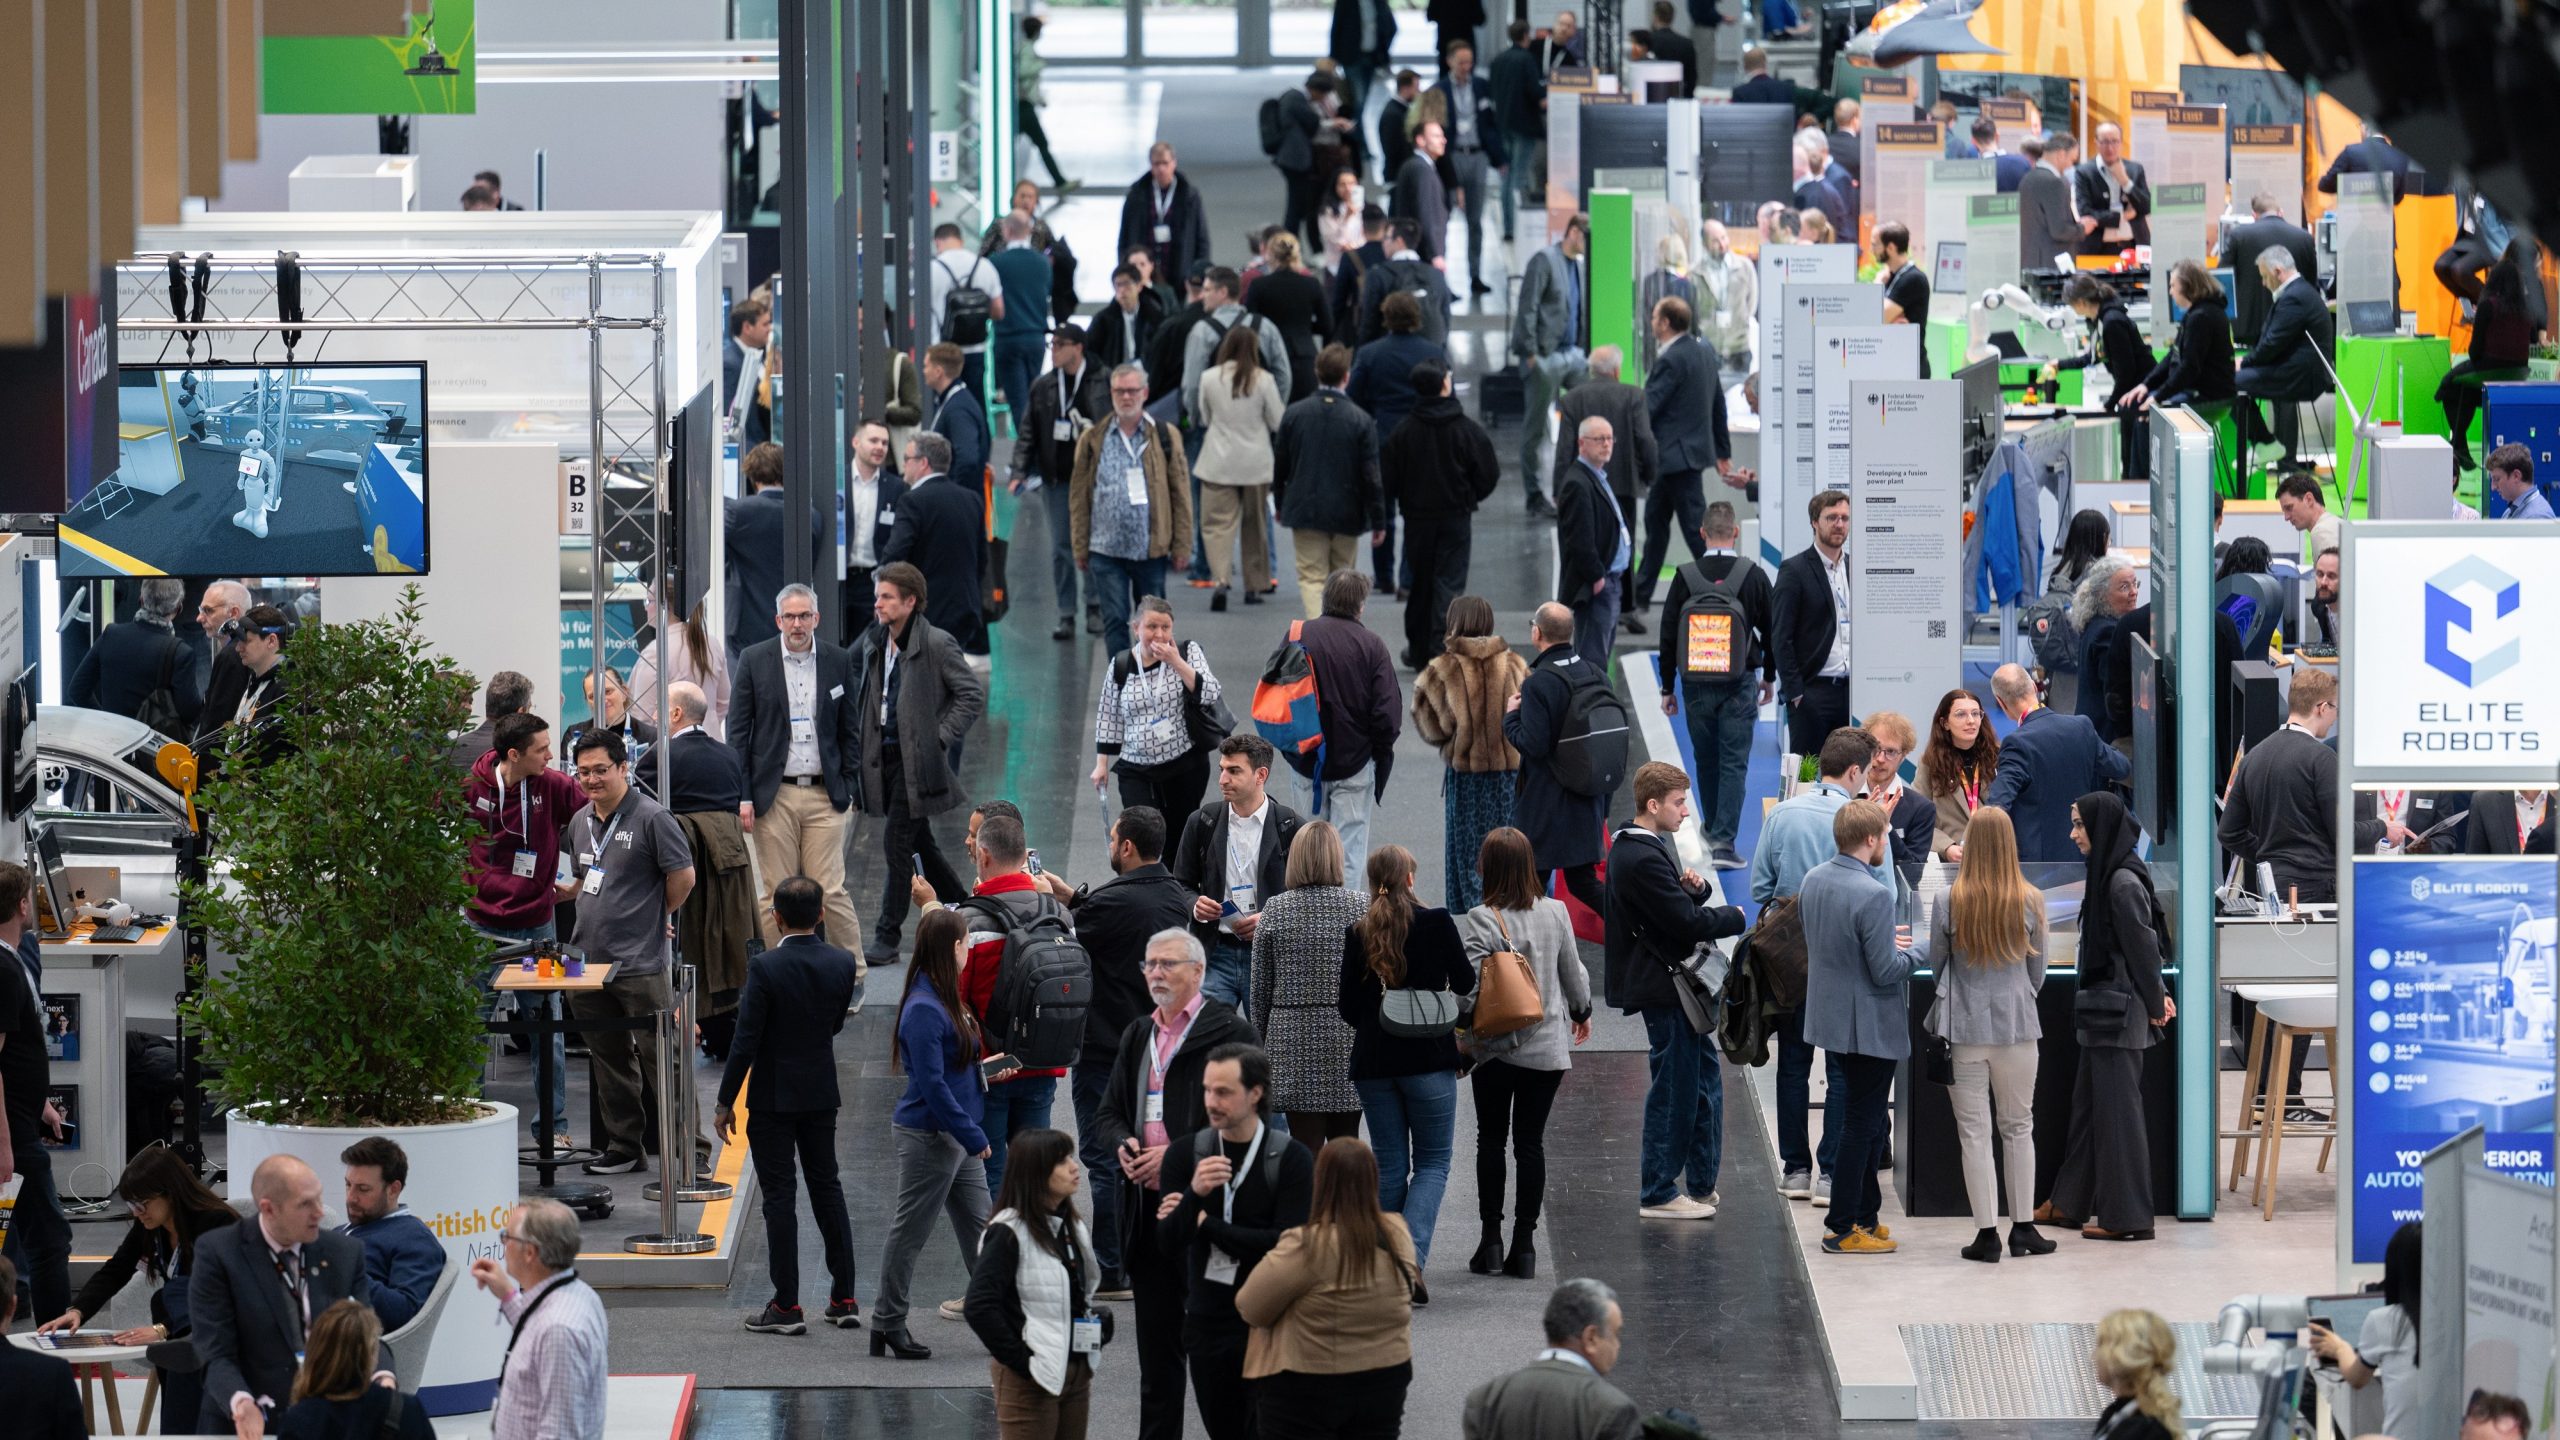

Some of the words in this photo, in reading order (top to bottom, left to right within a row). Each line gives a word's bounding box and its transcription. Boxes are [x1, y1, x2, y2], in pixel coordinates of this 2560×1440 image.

[1879, 126, 1892, 141] 14
[940, 141, 950, 155] B
[232, 286, 245, 296] for
[78, 304, 107, 395] Canada
[445, 376, 488, 389] recycling
[1867, 469, 1901, 478] Developing
[570, 475, 586, 497] B
[1887, 478, 1904, 486] plant
[571, 502, 584, 513] 32
[2419, 703, 2524, 722] ELITE
[2403, 732, 2540, 751] ROBOTS
[615, 830, 633, 842] dfki
[2433, 883, 2472, 894] ELITE
[2475, 883, 2529, 894] ROBOTS
[46, 1005, 65, 1013] next
[2395, 1150, 2427, 1168] YO
[416, 1208, 486, 1239] ritish
